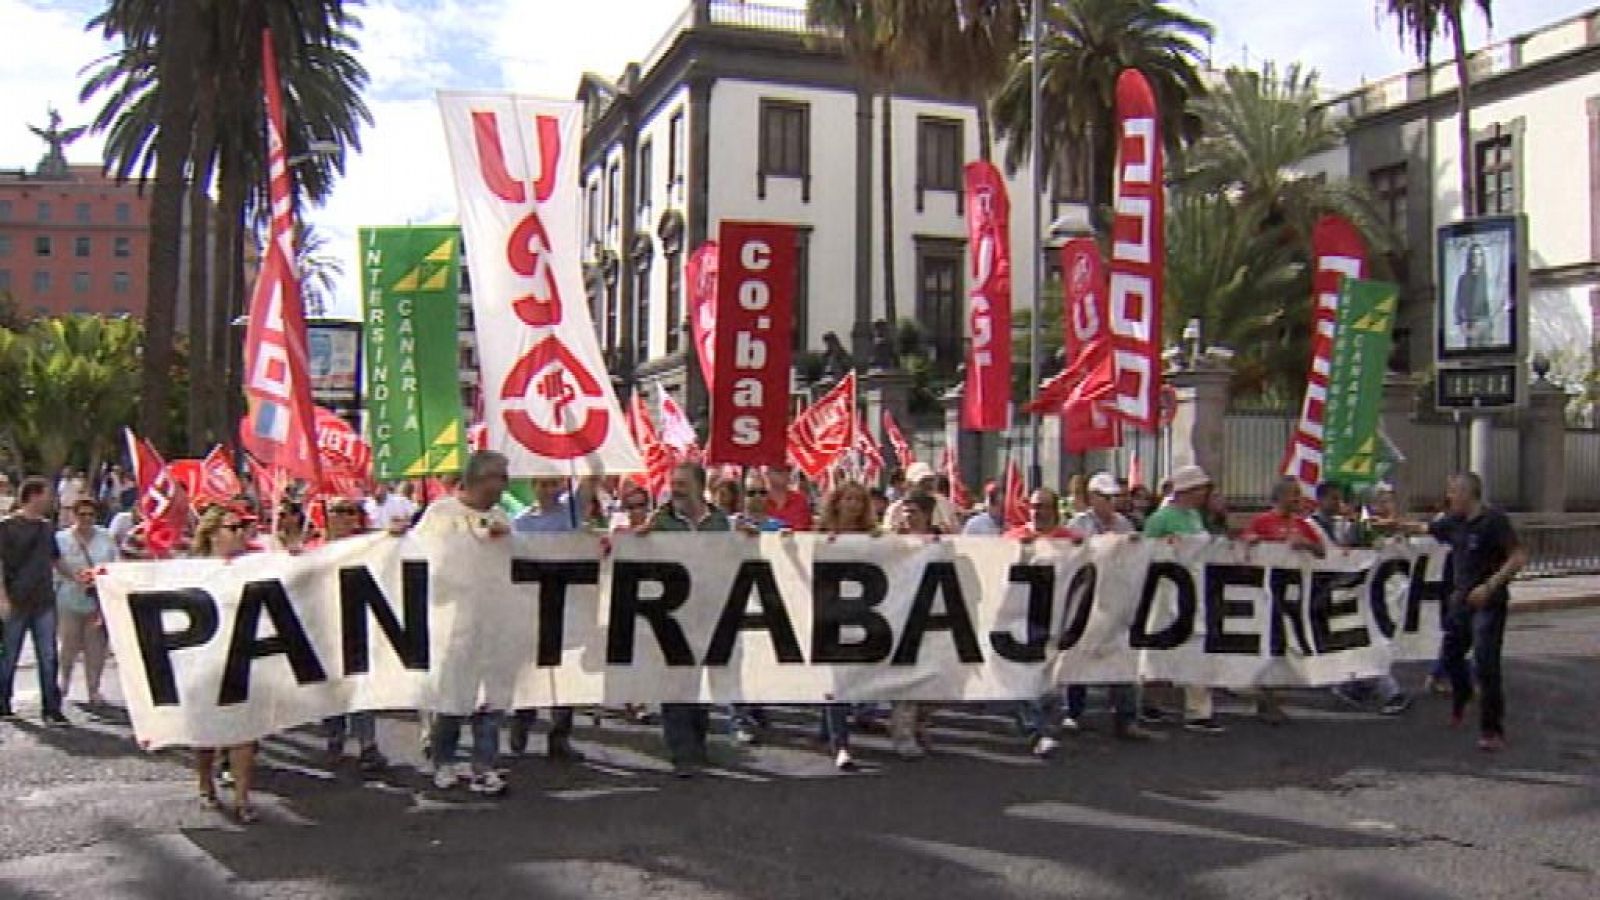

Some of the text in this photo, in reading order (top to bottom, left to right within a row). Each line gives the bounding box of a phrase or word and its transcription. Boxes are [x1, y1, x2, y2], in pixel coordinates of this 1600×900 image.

[367, 227, 393, 477] INTERSINDICAL
[397, 299, 419, 431] CANARIA
[471, 111, 609, 461] USO
[731, 240, 772, 446] co.bas
[127, 553, 1452, 707] PAN TRABAJO DERECH
